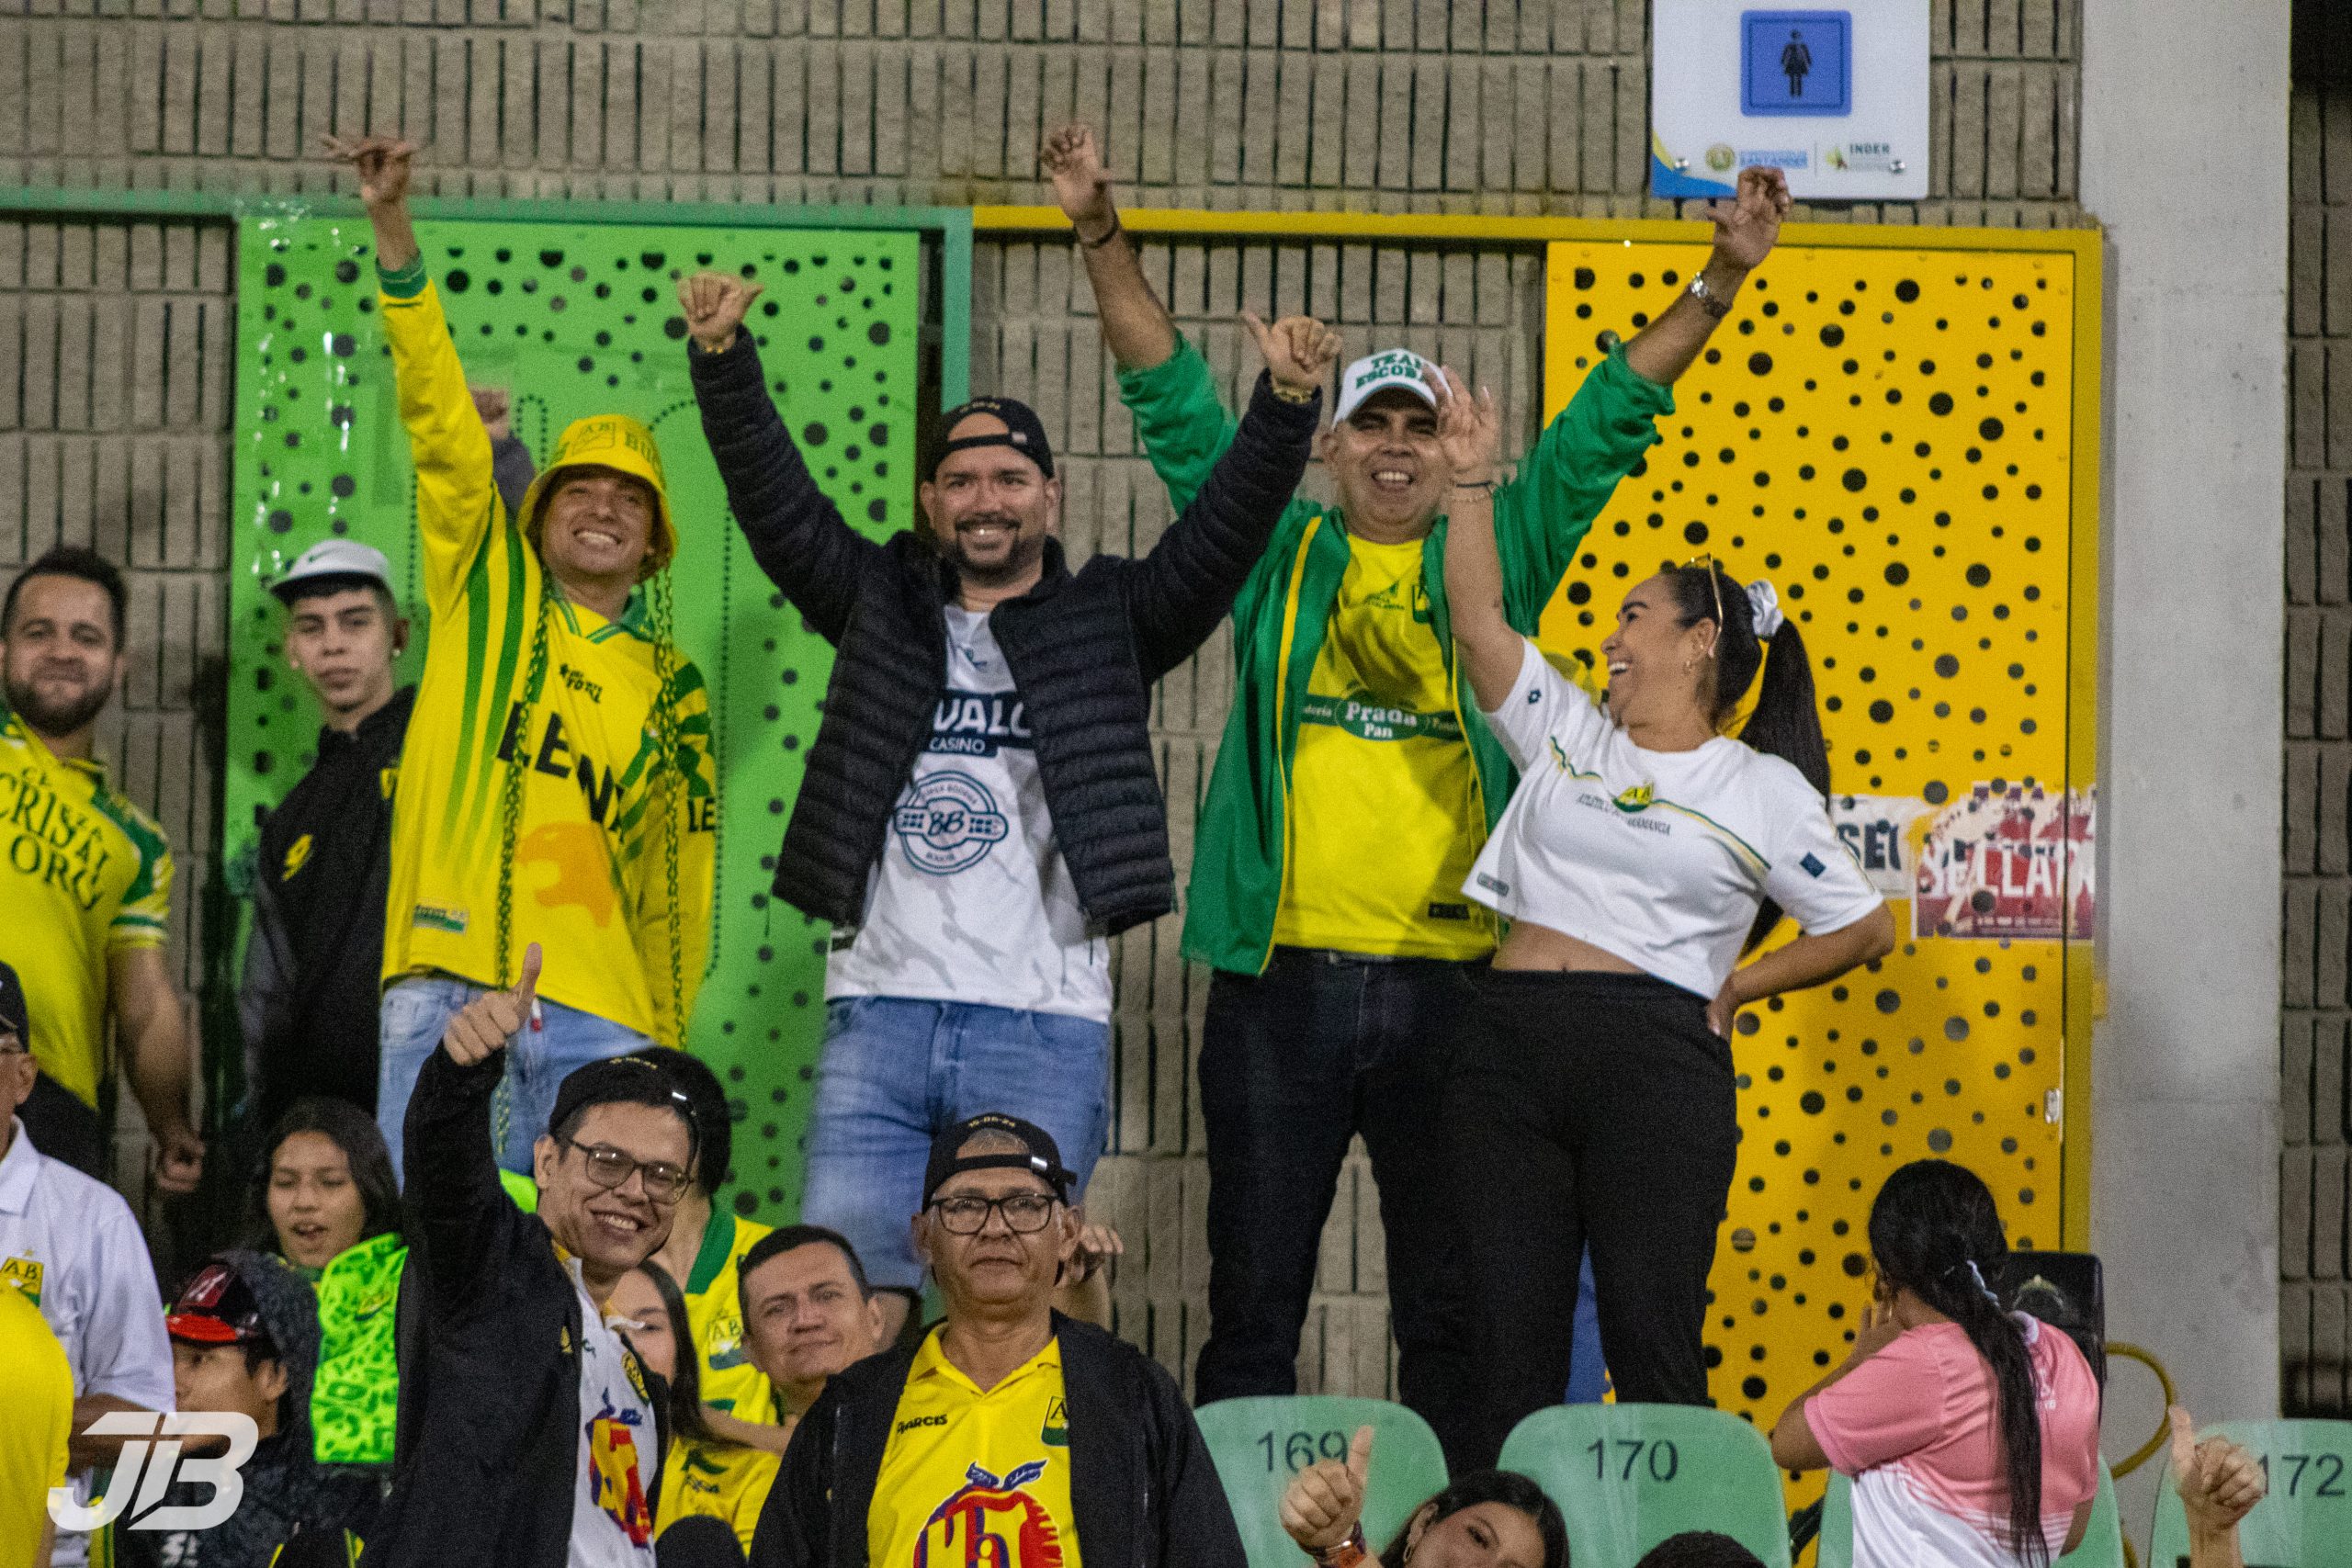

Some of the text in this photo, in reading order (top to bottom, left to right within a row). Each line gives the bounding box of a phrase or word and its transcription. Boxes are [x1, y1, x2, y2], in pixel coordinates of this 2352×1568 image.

[1364, 723, 1393, 739] Pan
[929, 737, 986, 754] CASINO
[927, 809, 966, 837] BB
[897, 1413, 948, 1435] GARCIS
[1257, 1431, 1349, 1474] 169
[1587, 1438, 1679, 1483] 170
[2257, 1453, 2346, 1497] 172
